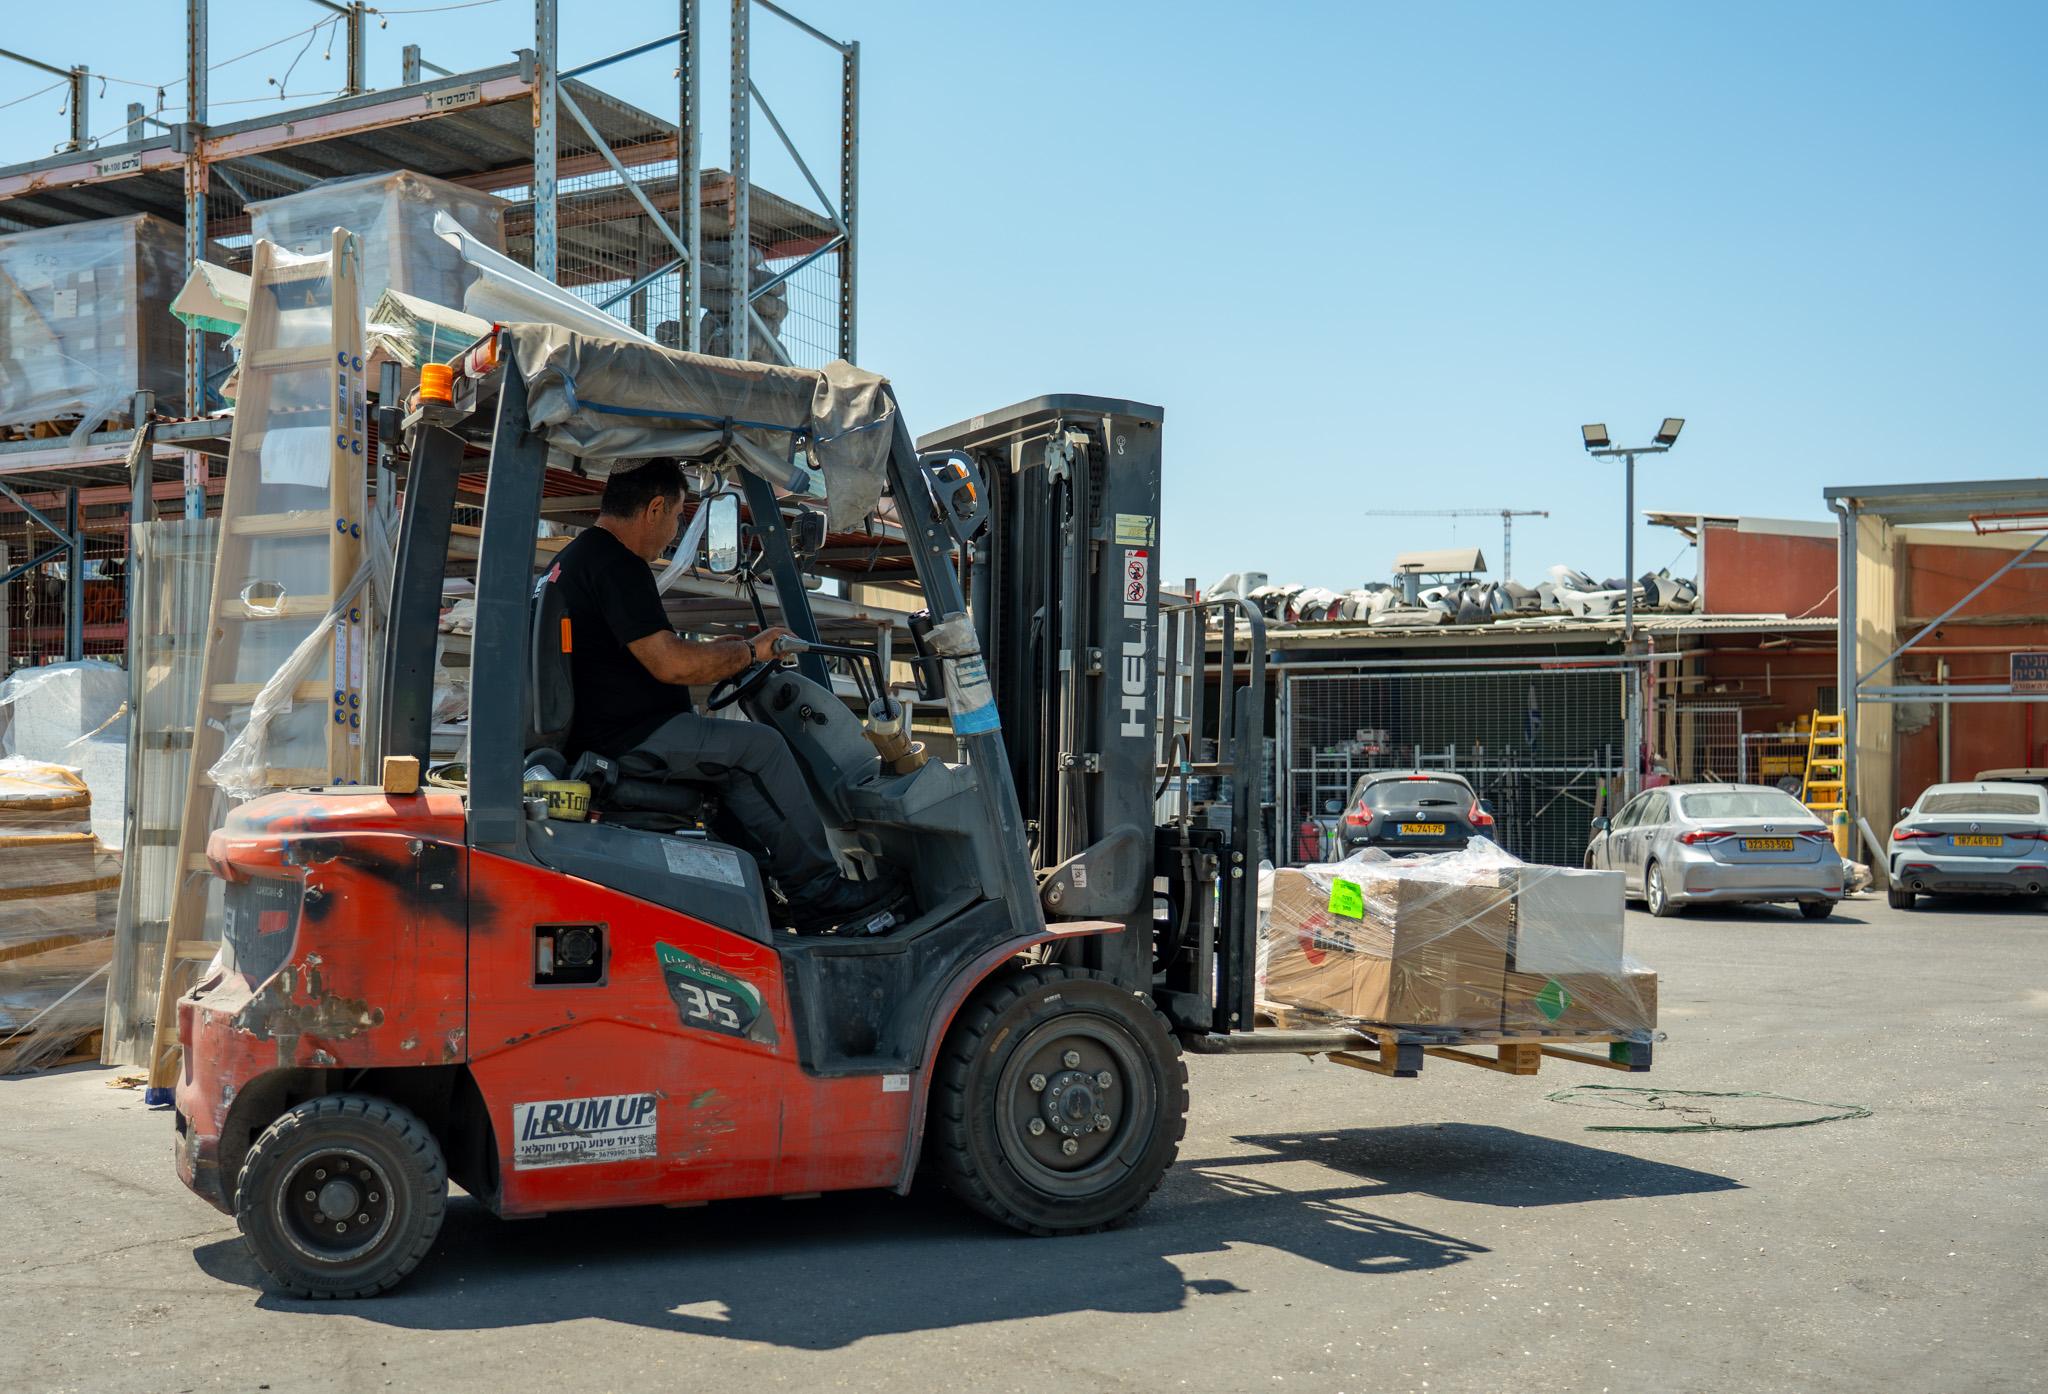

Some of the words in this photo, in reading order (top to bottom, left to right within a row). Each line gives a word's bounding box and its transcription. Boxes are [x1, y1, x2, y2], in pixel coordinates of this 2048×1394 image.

[1121, 604, 1147, 737] HELI
[679, 982, 740, 1029] 35
[615, 1096, 656, 1126] UP
[558, 1140, 587, 1152] הנדסי
[588, 1137, 615, 1149] שינוע
[617, 1135, 636, 1146] ציוד
